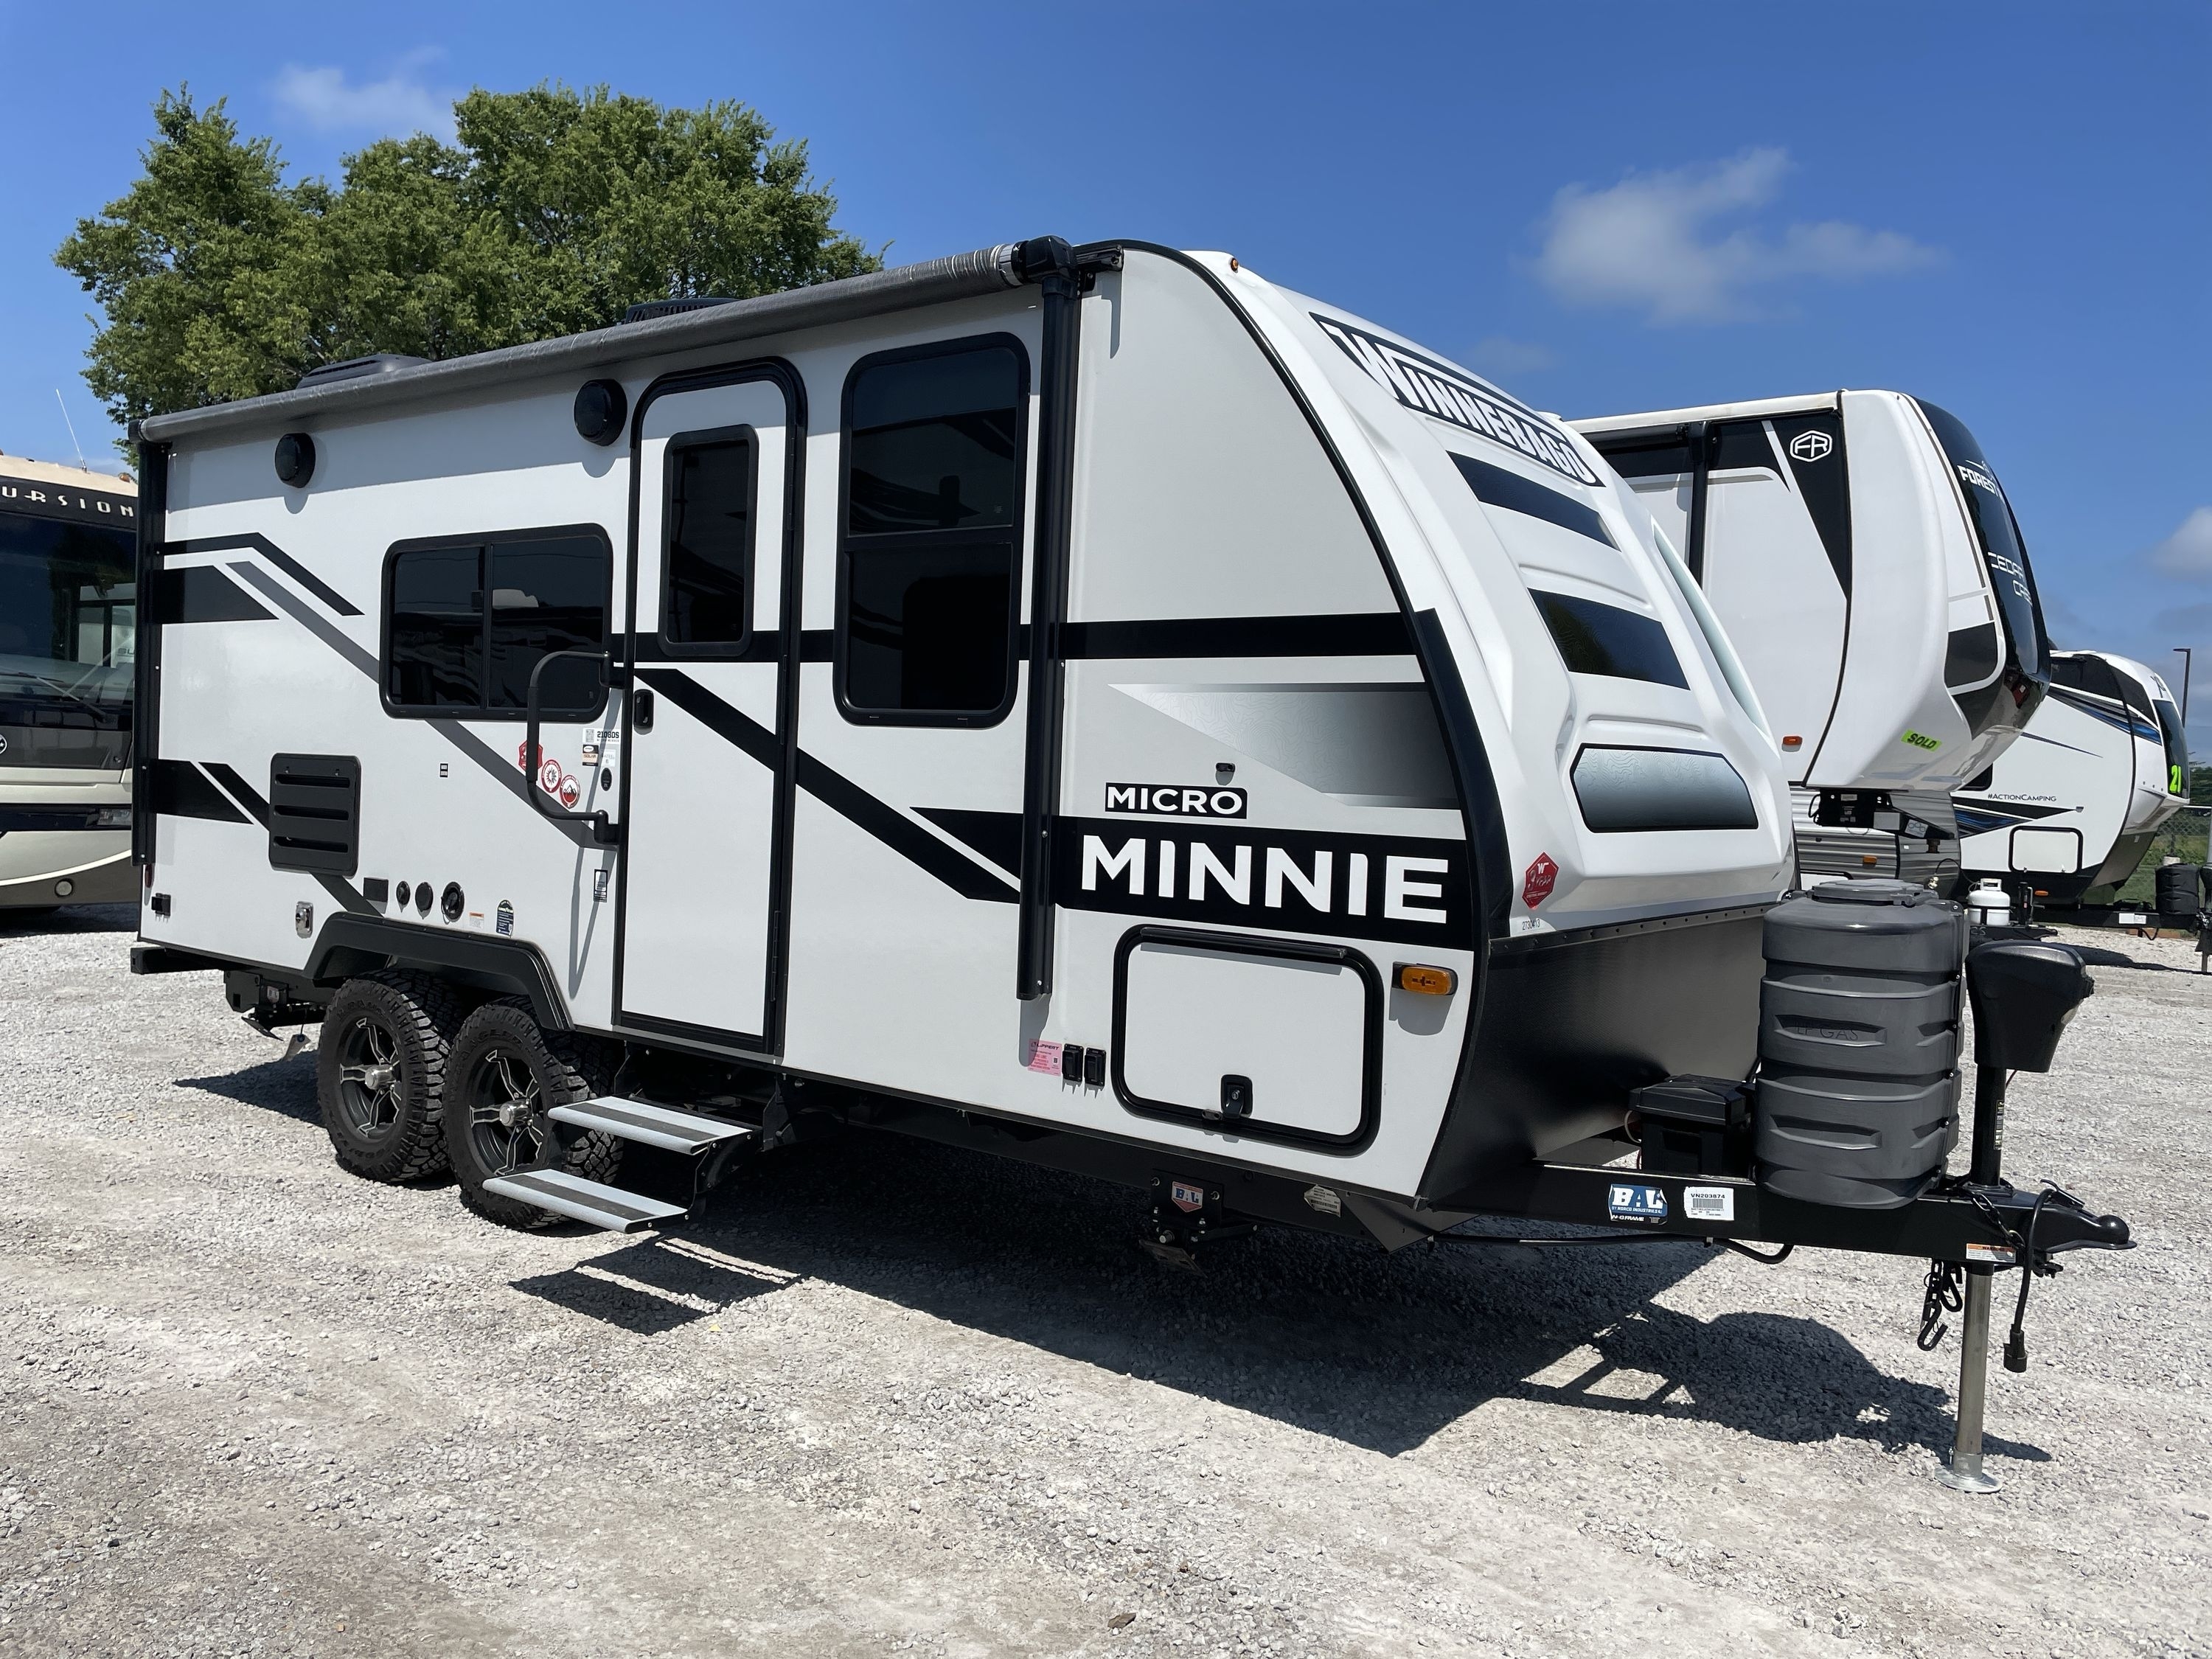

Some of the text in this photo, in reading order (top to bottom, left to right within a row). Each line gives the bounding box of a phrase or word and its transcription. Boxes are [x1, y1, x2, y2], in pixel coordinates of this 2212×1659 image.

[1320, 321, 1597, 484] WINNEBAGO
[1957, 465, 1998, 497] FOREST
[1, 486, 134, 517] URSION
[1907, 733, 1937, 749] SOLD
[1107, 786, 1242, 815] MICRO
[1082, 835, 1449, 924] MINNIE
[1523, 919, 1540, 931] 2730413
[1820, 1026, 1858, 1041] GAS
[1612, 1187, 1663, 1209] BAL
